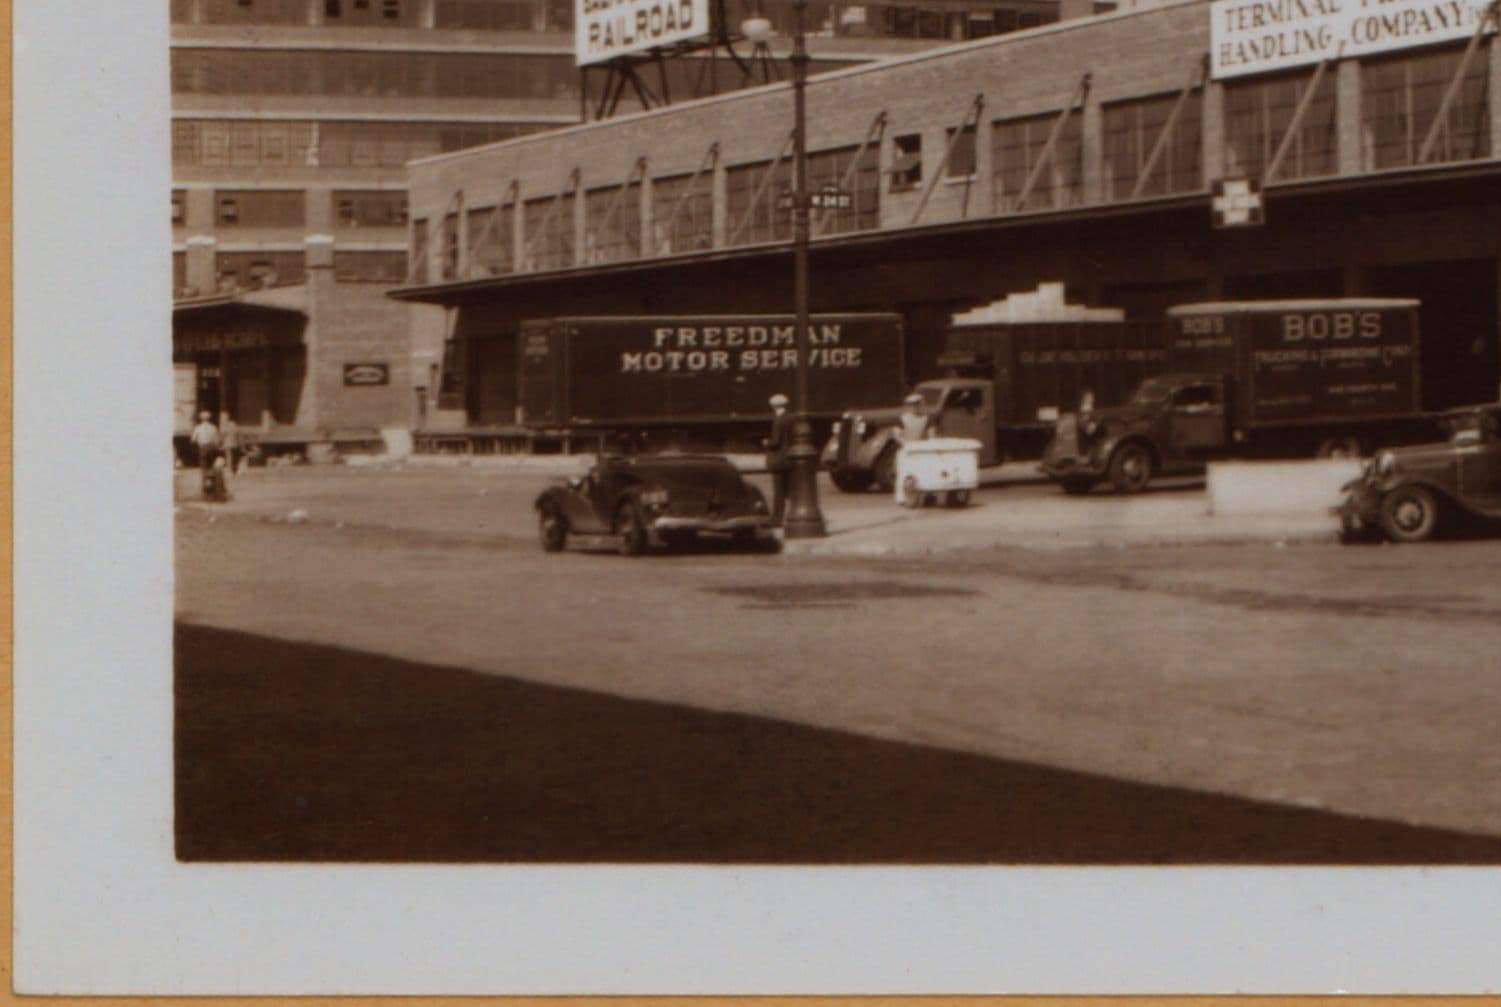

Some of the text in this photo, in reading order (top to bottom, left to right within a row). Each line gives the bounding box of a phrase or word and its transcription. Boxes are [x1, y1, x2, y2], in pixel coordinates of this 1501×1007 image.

[1219, 24, 1332, 67] HANDLING
[1351, 0, 1466, 43] COMPANY
[1284, 311, 1382, 341] BOB'S
[622, 348, 862, 372] MOTOR SERVICE
